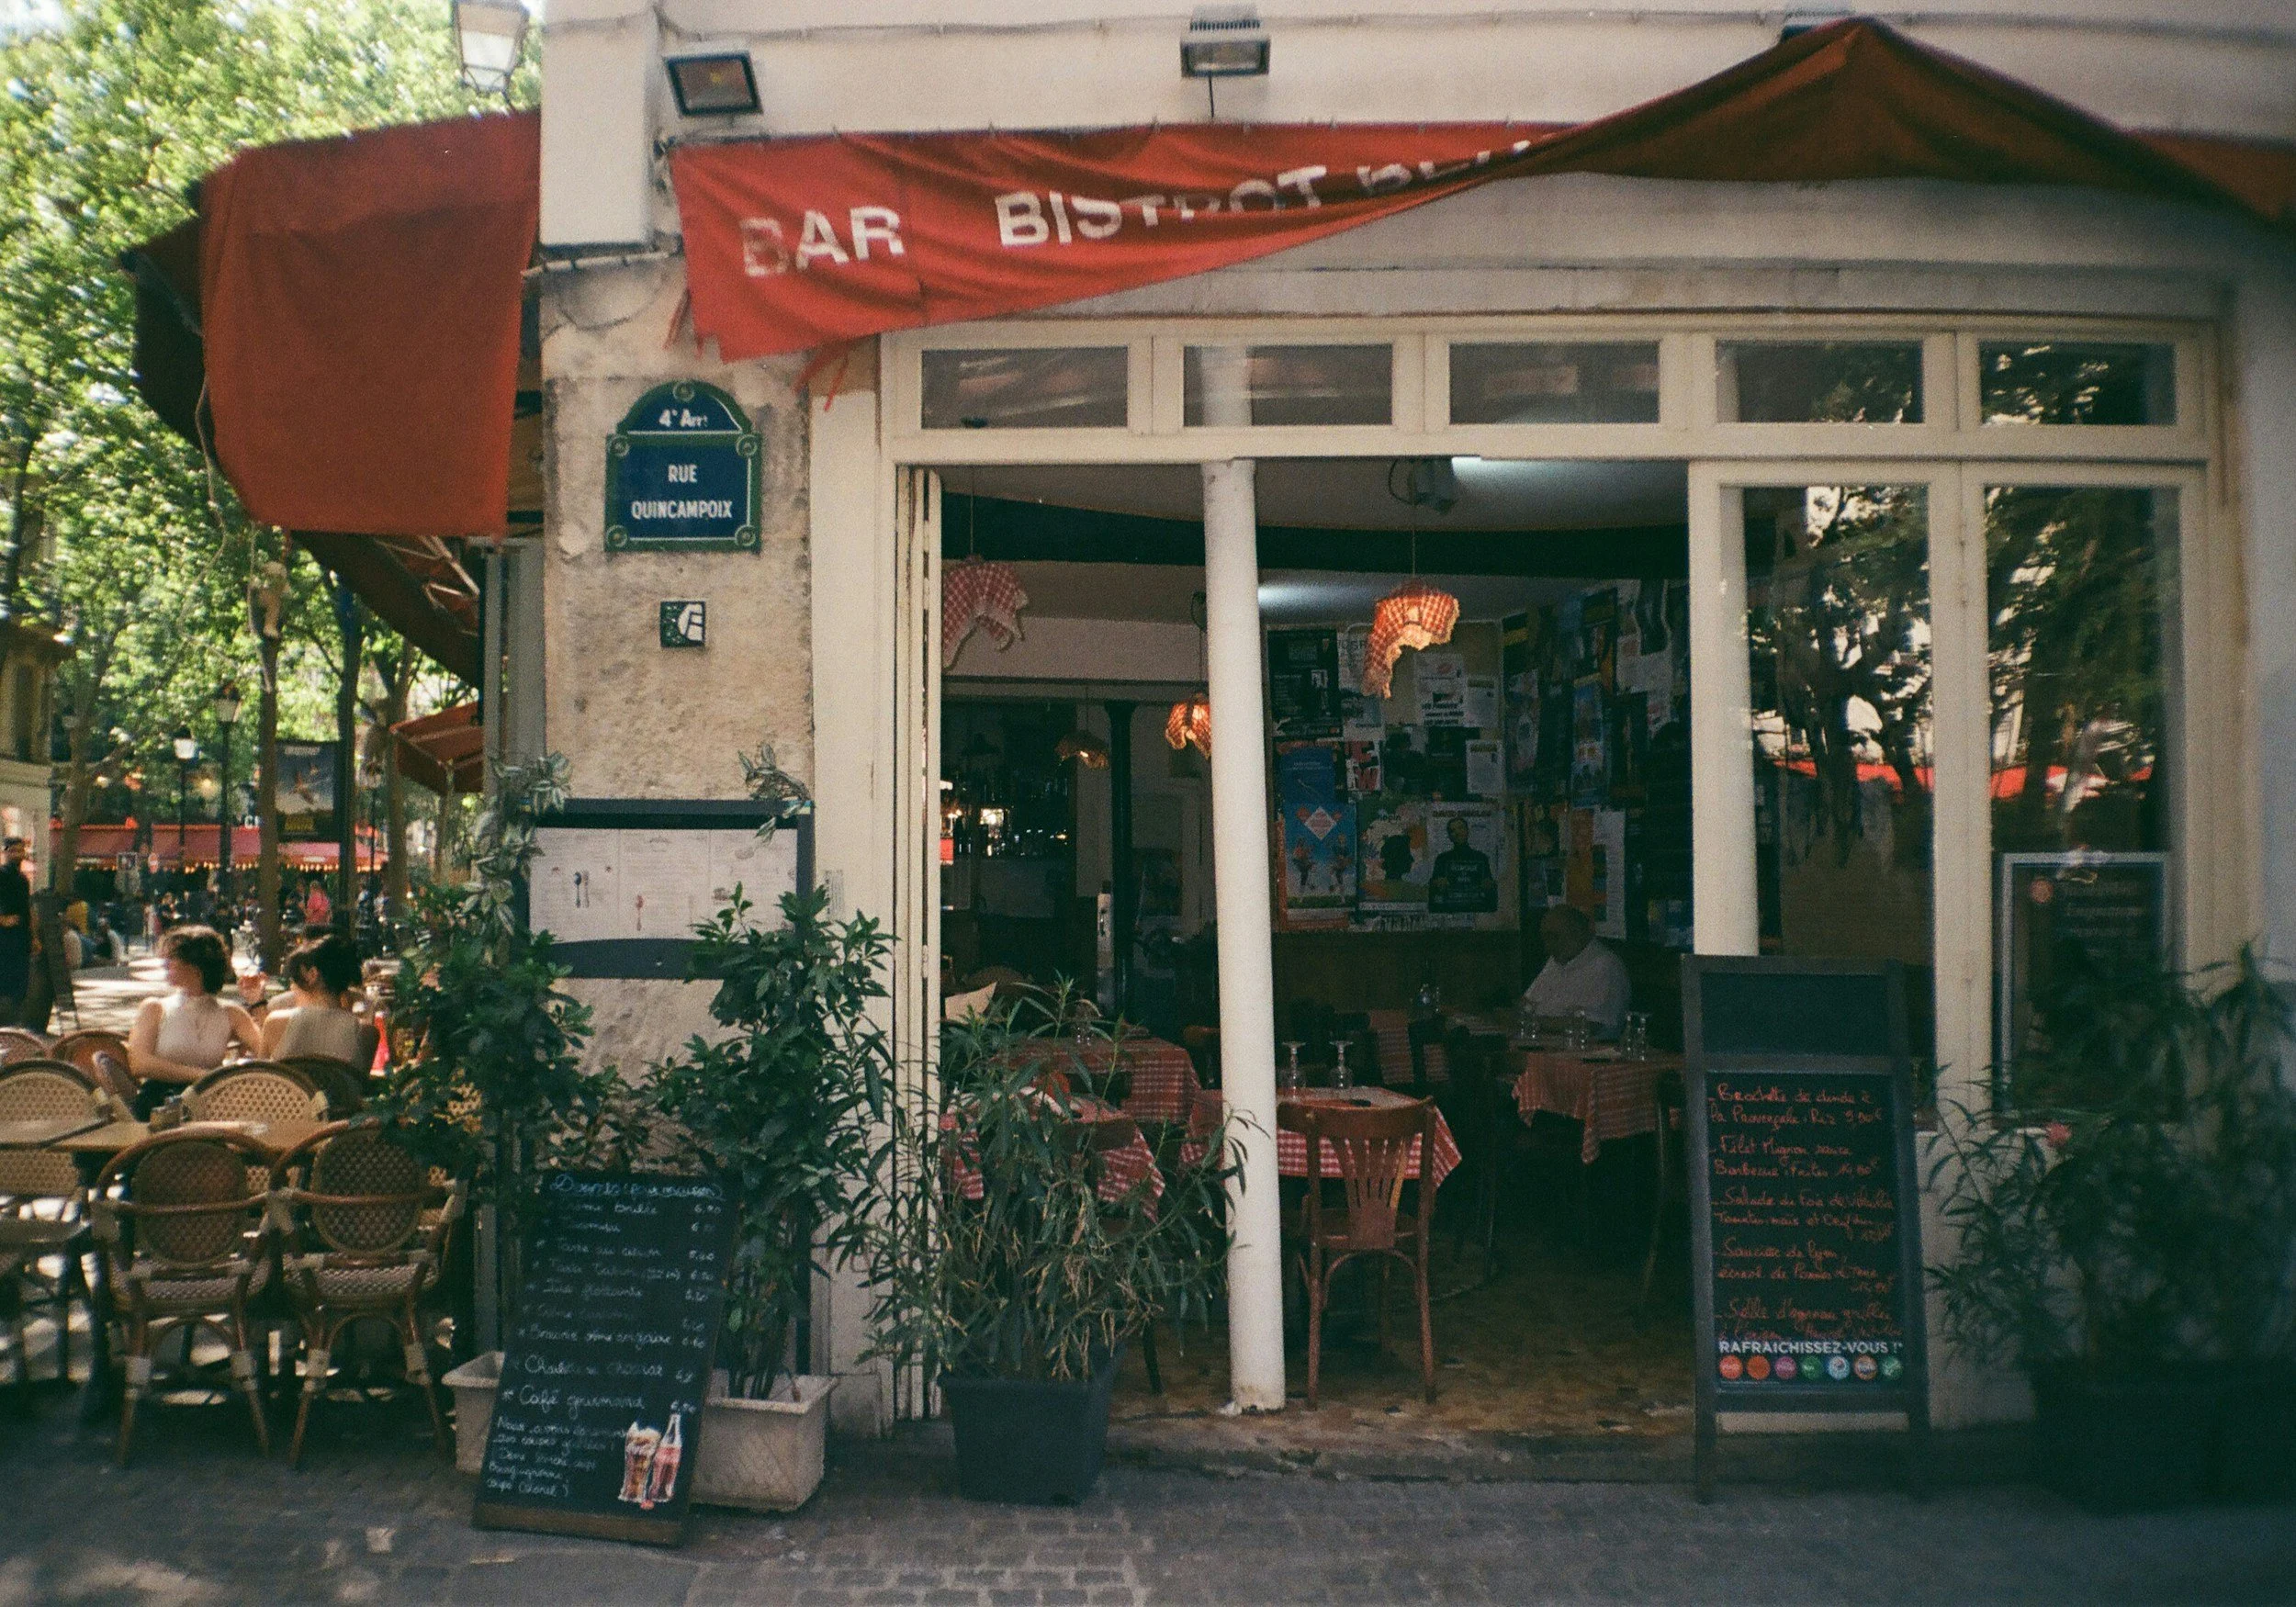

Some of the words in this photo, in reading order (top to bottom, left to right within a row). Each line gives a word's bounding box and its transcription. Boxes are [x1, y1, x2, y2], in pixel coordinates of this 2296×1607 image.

[737, 207, 904, 276] BAR
[668, 465, 698, 483] RUE
[631, 500, 733, 520] QUINCAMPOIX
[1720, 1134, 1756, 1153] Filet
[519, 1384, 561, 1413] Café
